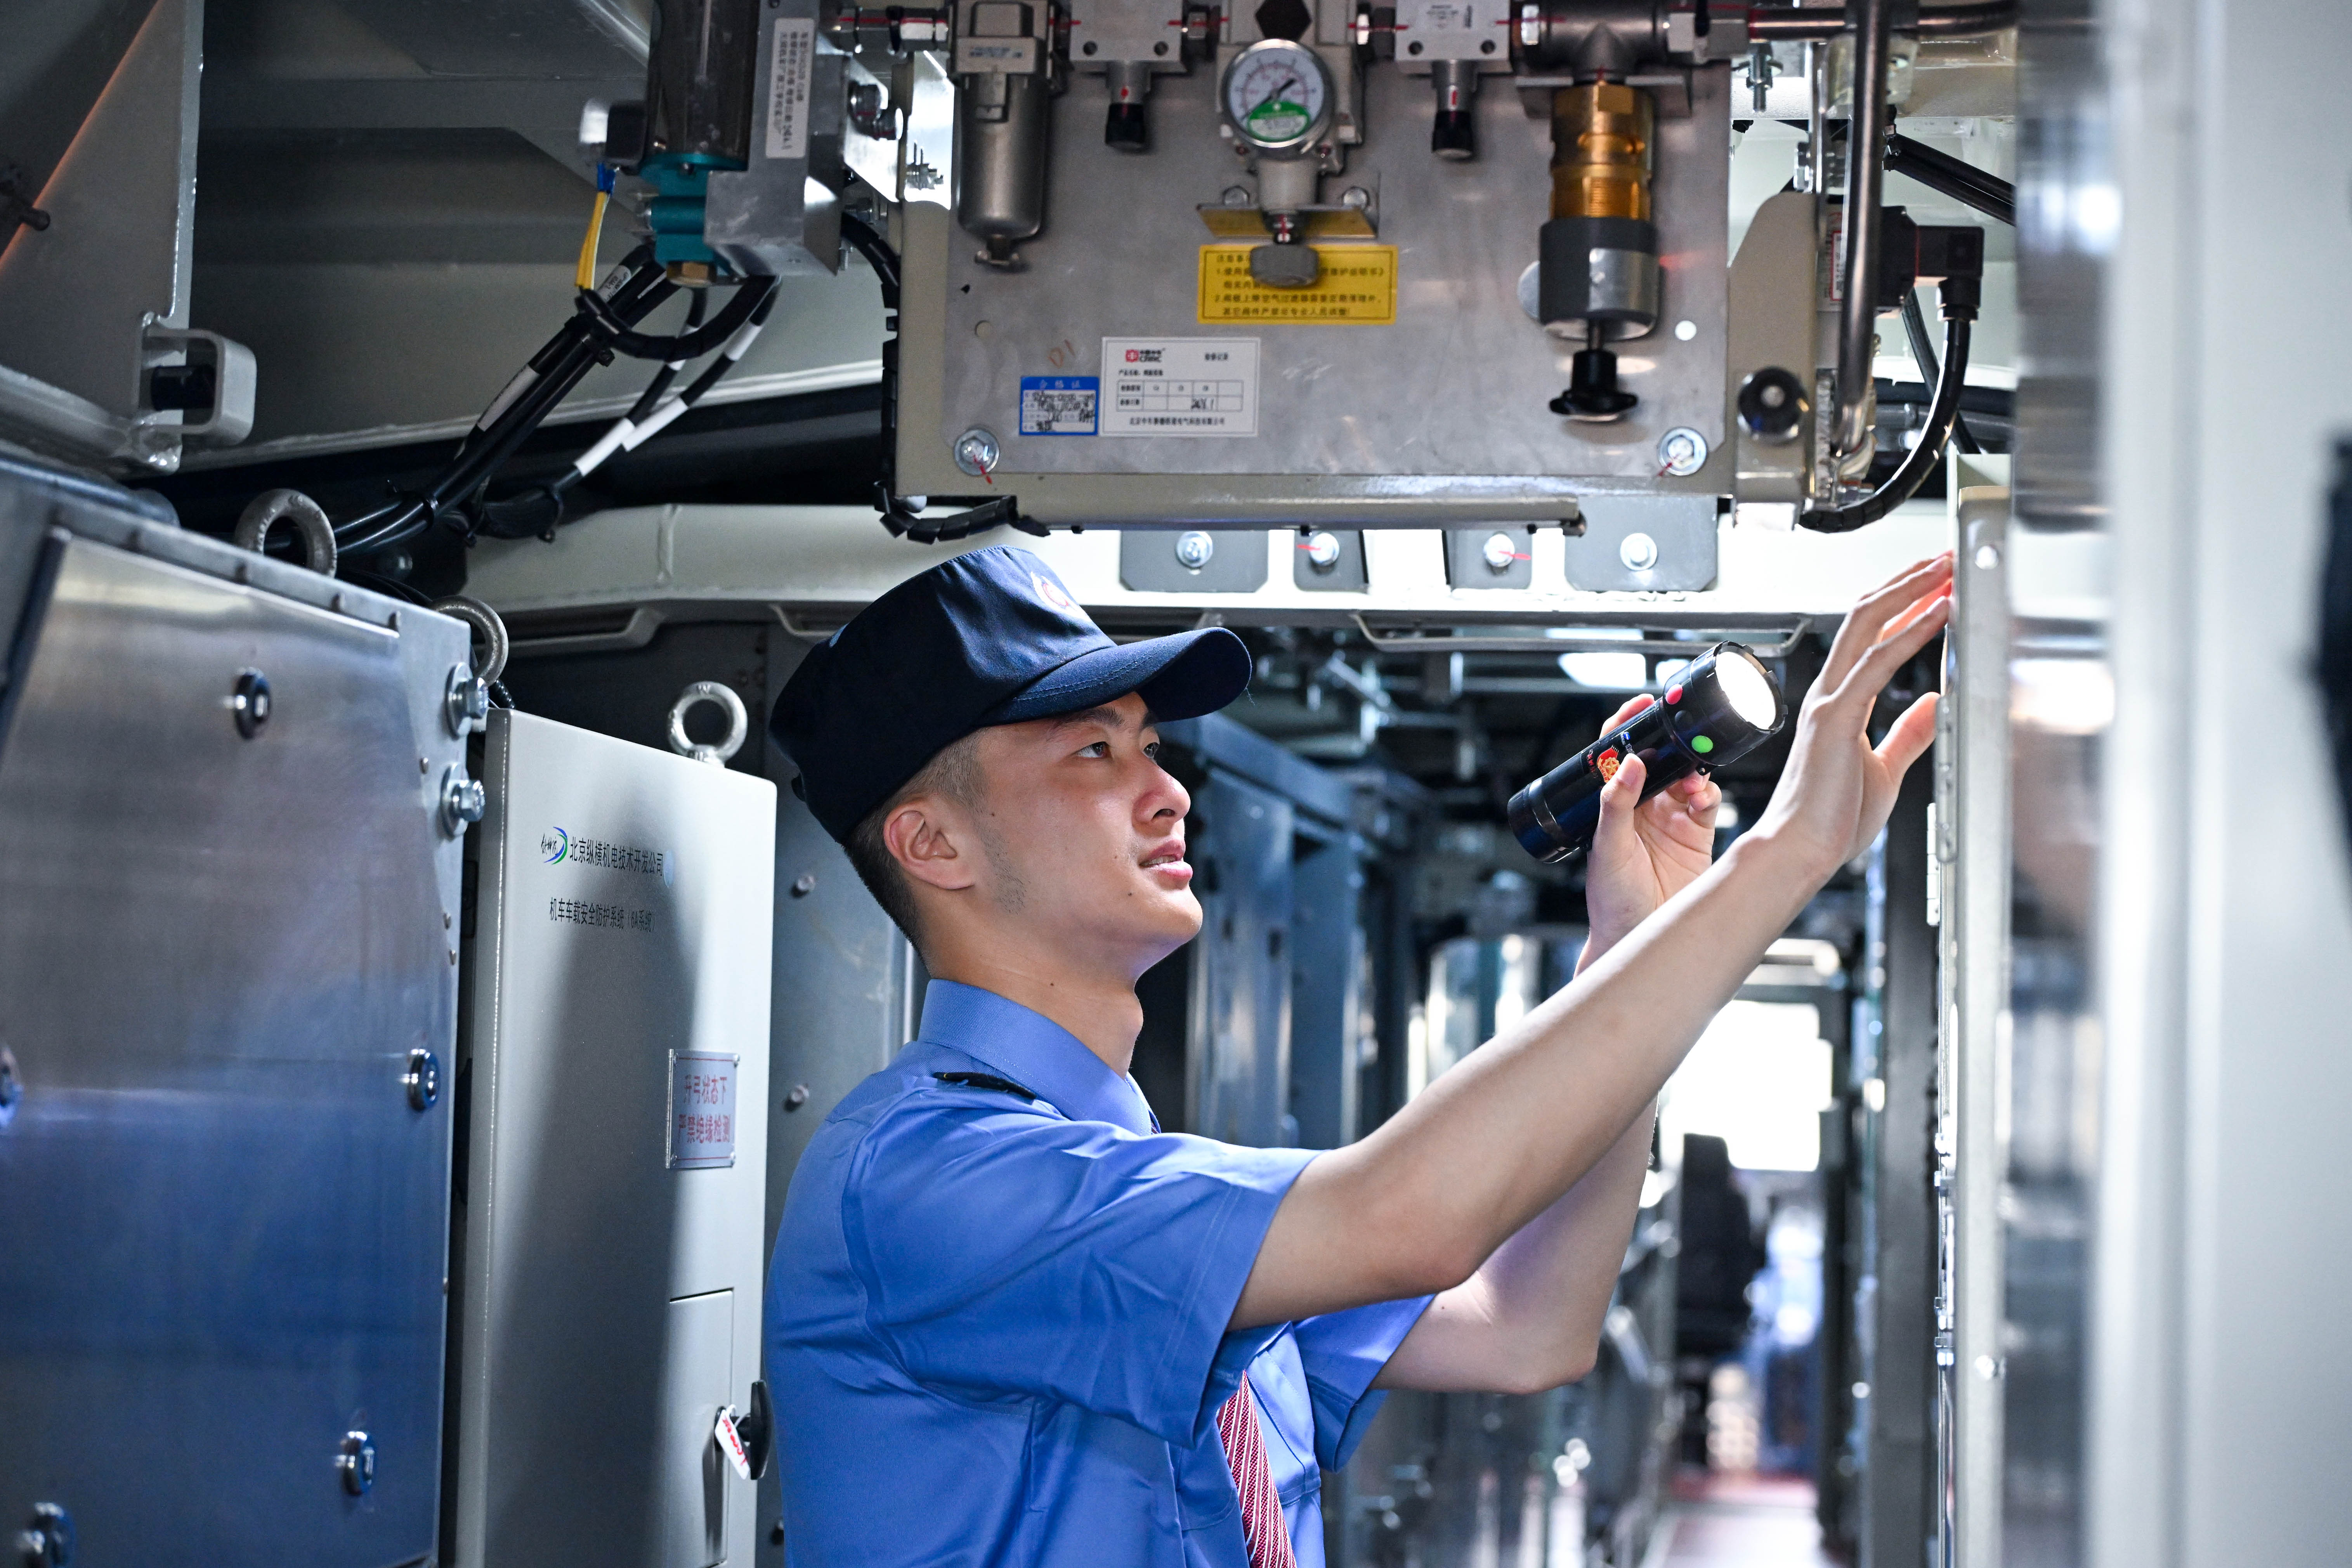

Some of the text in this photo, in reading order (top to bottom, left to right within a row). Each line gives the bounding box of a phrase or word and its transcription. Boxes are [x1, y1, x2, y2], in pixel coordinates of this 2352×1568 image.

[570, 836, 664, 876] 北京纵横机电技术开发公司
[683, 1074, 727, 1105] 升弓状态下
[679, 1114, 731, 1144] 严禁绝缘检测
